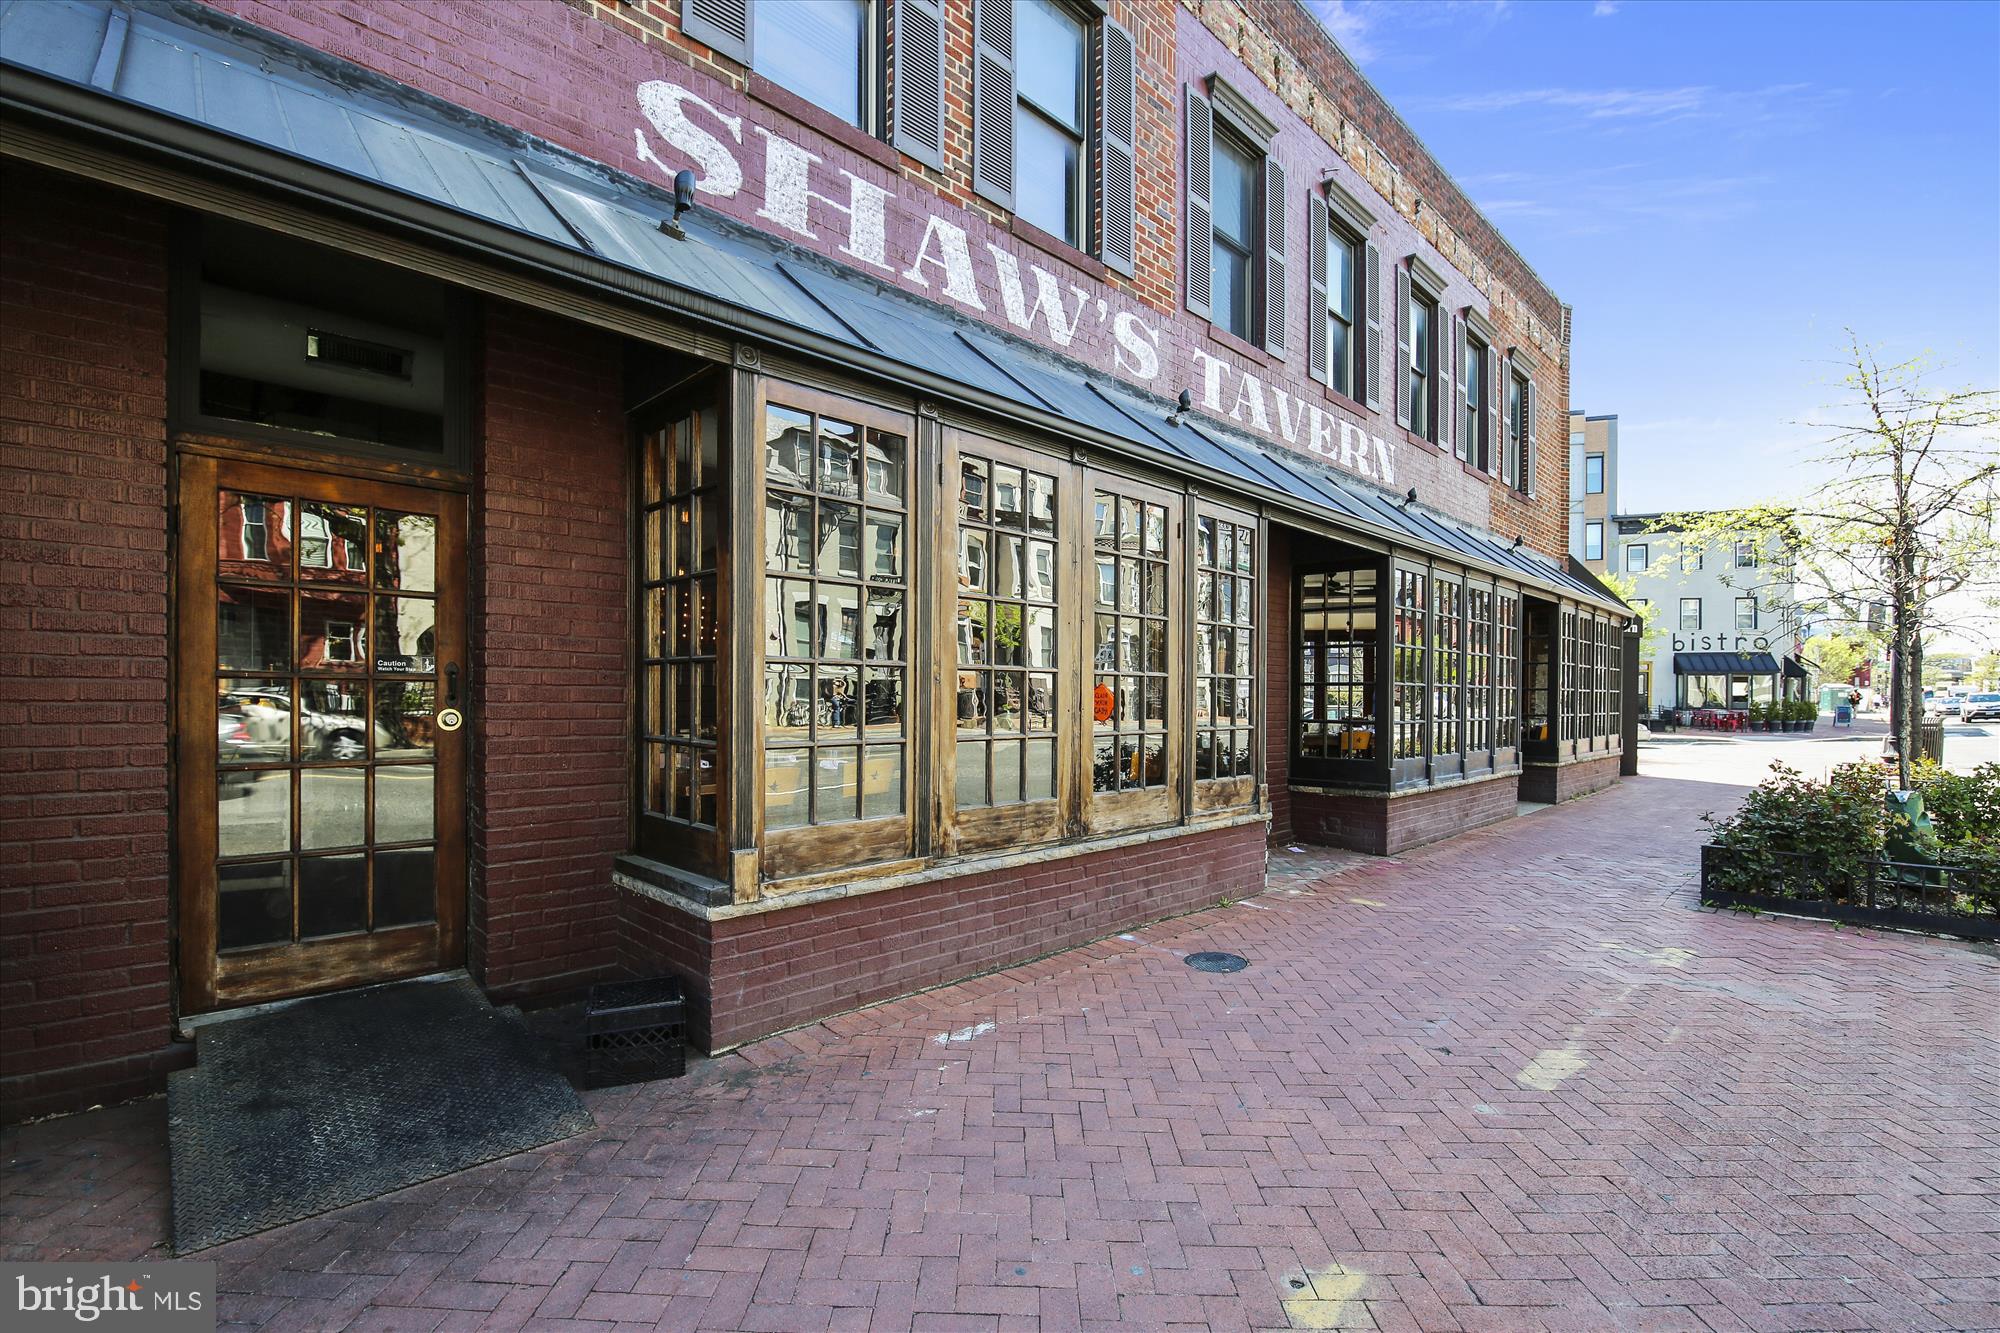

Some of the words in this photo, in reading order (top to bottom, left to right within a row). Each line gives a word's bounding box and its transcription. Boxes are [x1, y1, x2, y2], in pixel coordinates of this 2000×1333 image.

[634, 79, 1160, 380] SHAW'S
[1192, 346, 1396, 485] TAVERN
[1672, 632, 1769, 652] bistro
[377, 659, 407, 667] Caution
